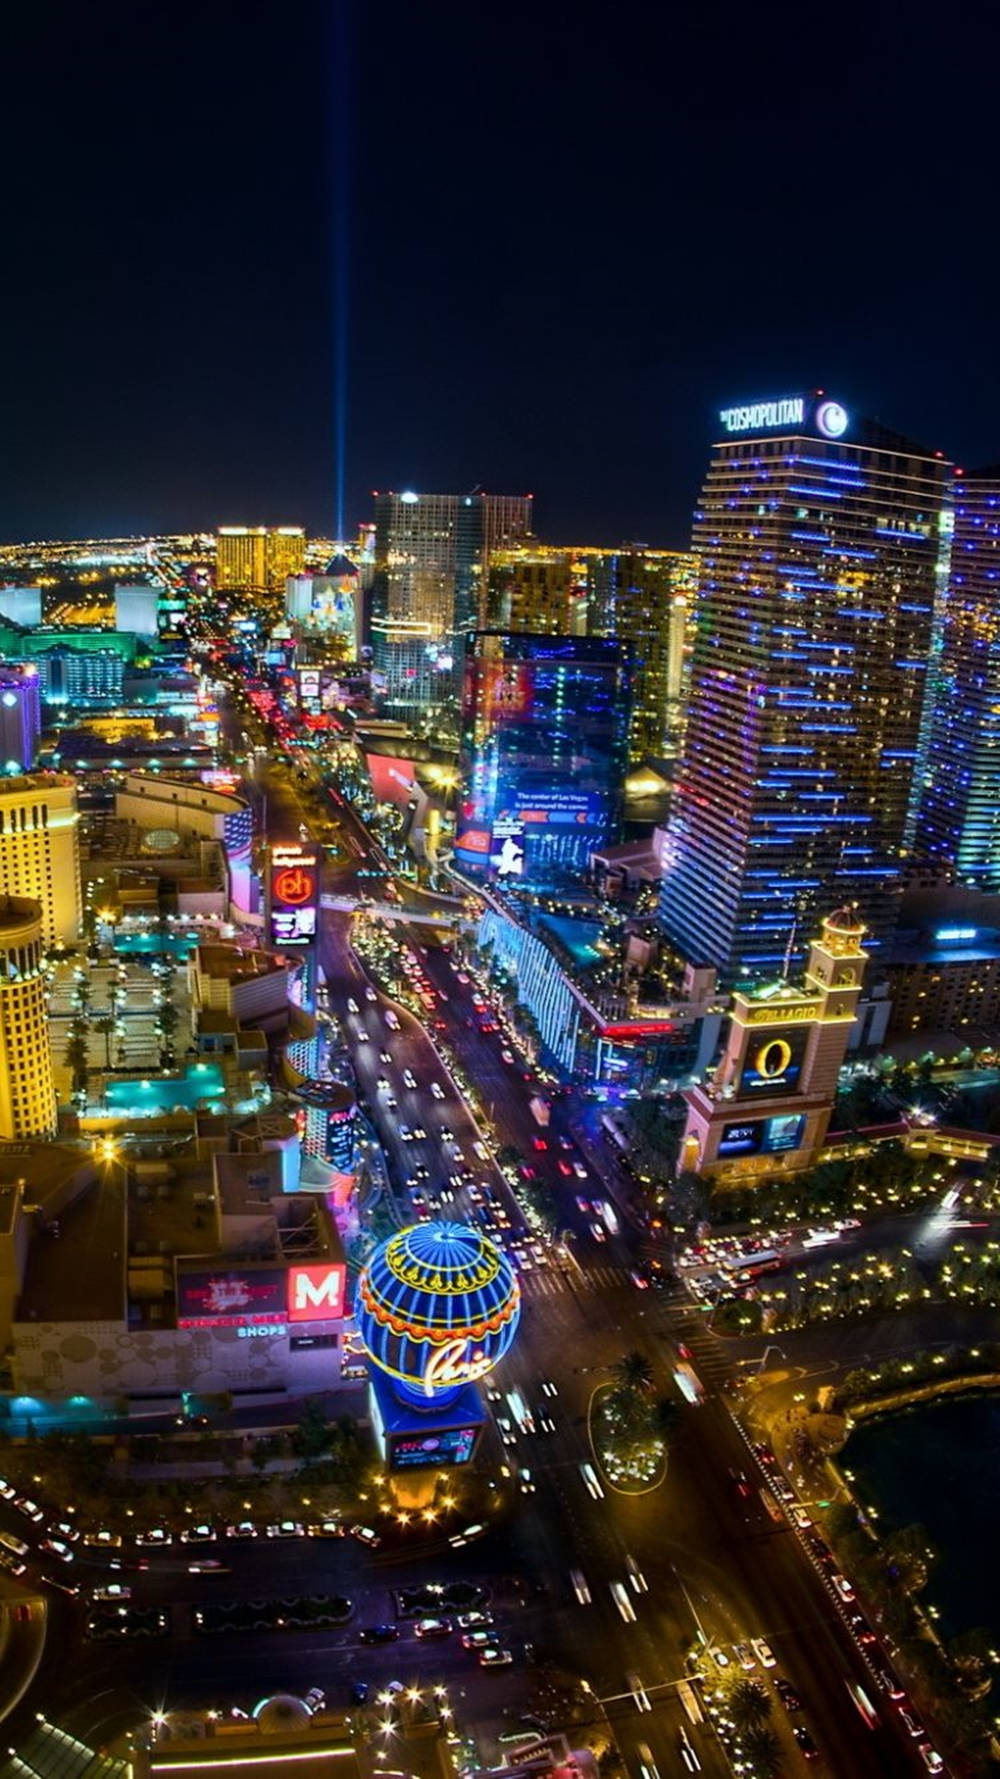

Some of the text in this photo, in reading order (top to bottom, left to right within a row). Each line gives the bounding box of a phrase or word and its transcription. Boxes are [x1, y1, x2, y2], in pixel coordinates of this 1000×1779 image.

[727, 399, 803, 431] COSMOPOLITAN
[534, 802, 557, 810] around
[755, 1039, 791, 1078] O
[295, 1271, 340, 1309] M
[237, 1326, 287, 1338] SHOPS
[424, 1339, 491, 1397] Paris
